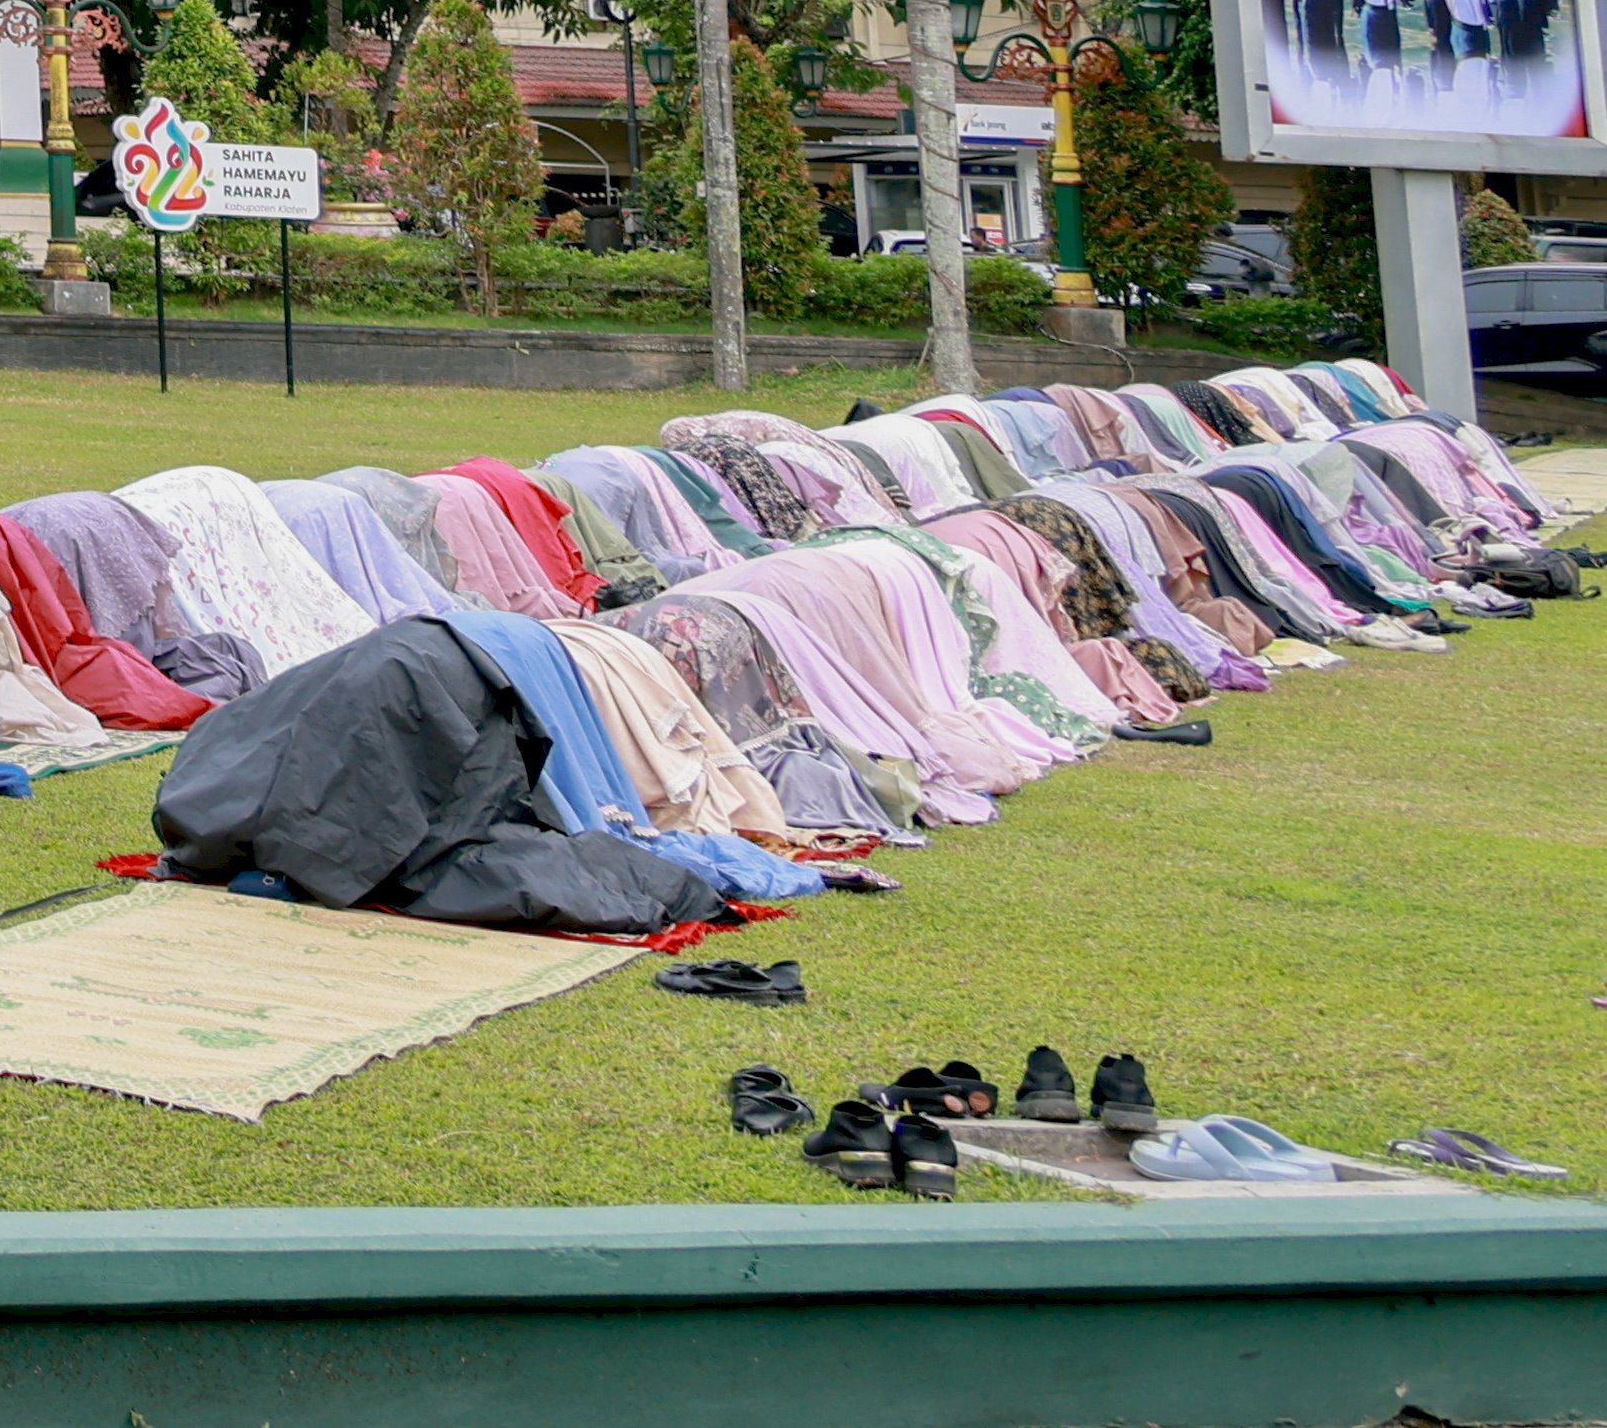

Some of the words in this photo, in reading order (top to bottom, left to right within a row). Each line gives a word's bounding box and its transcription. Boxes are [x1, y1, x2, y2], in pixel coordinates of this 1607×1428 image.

[222, 149, 274, 163] SAHITA
[223, 167, 306, 182] HAMEMAYU
[223, 185, 291, 199] RAHARJA
[224, 202, 276, 213] Kabupaten
[277, 204, 308, 214] Klaten
